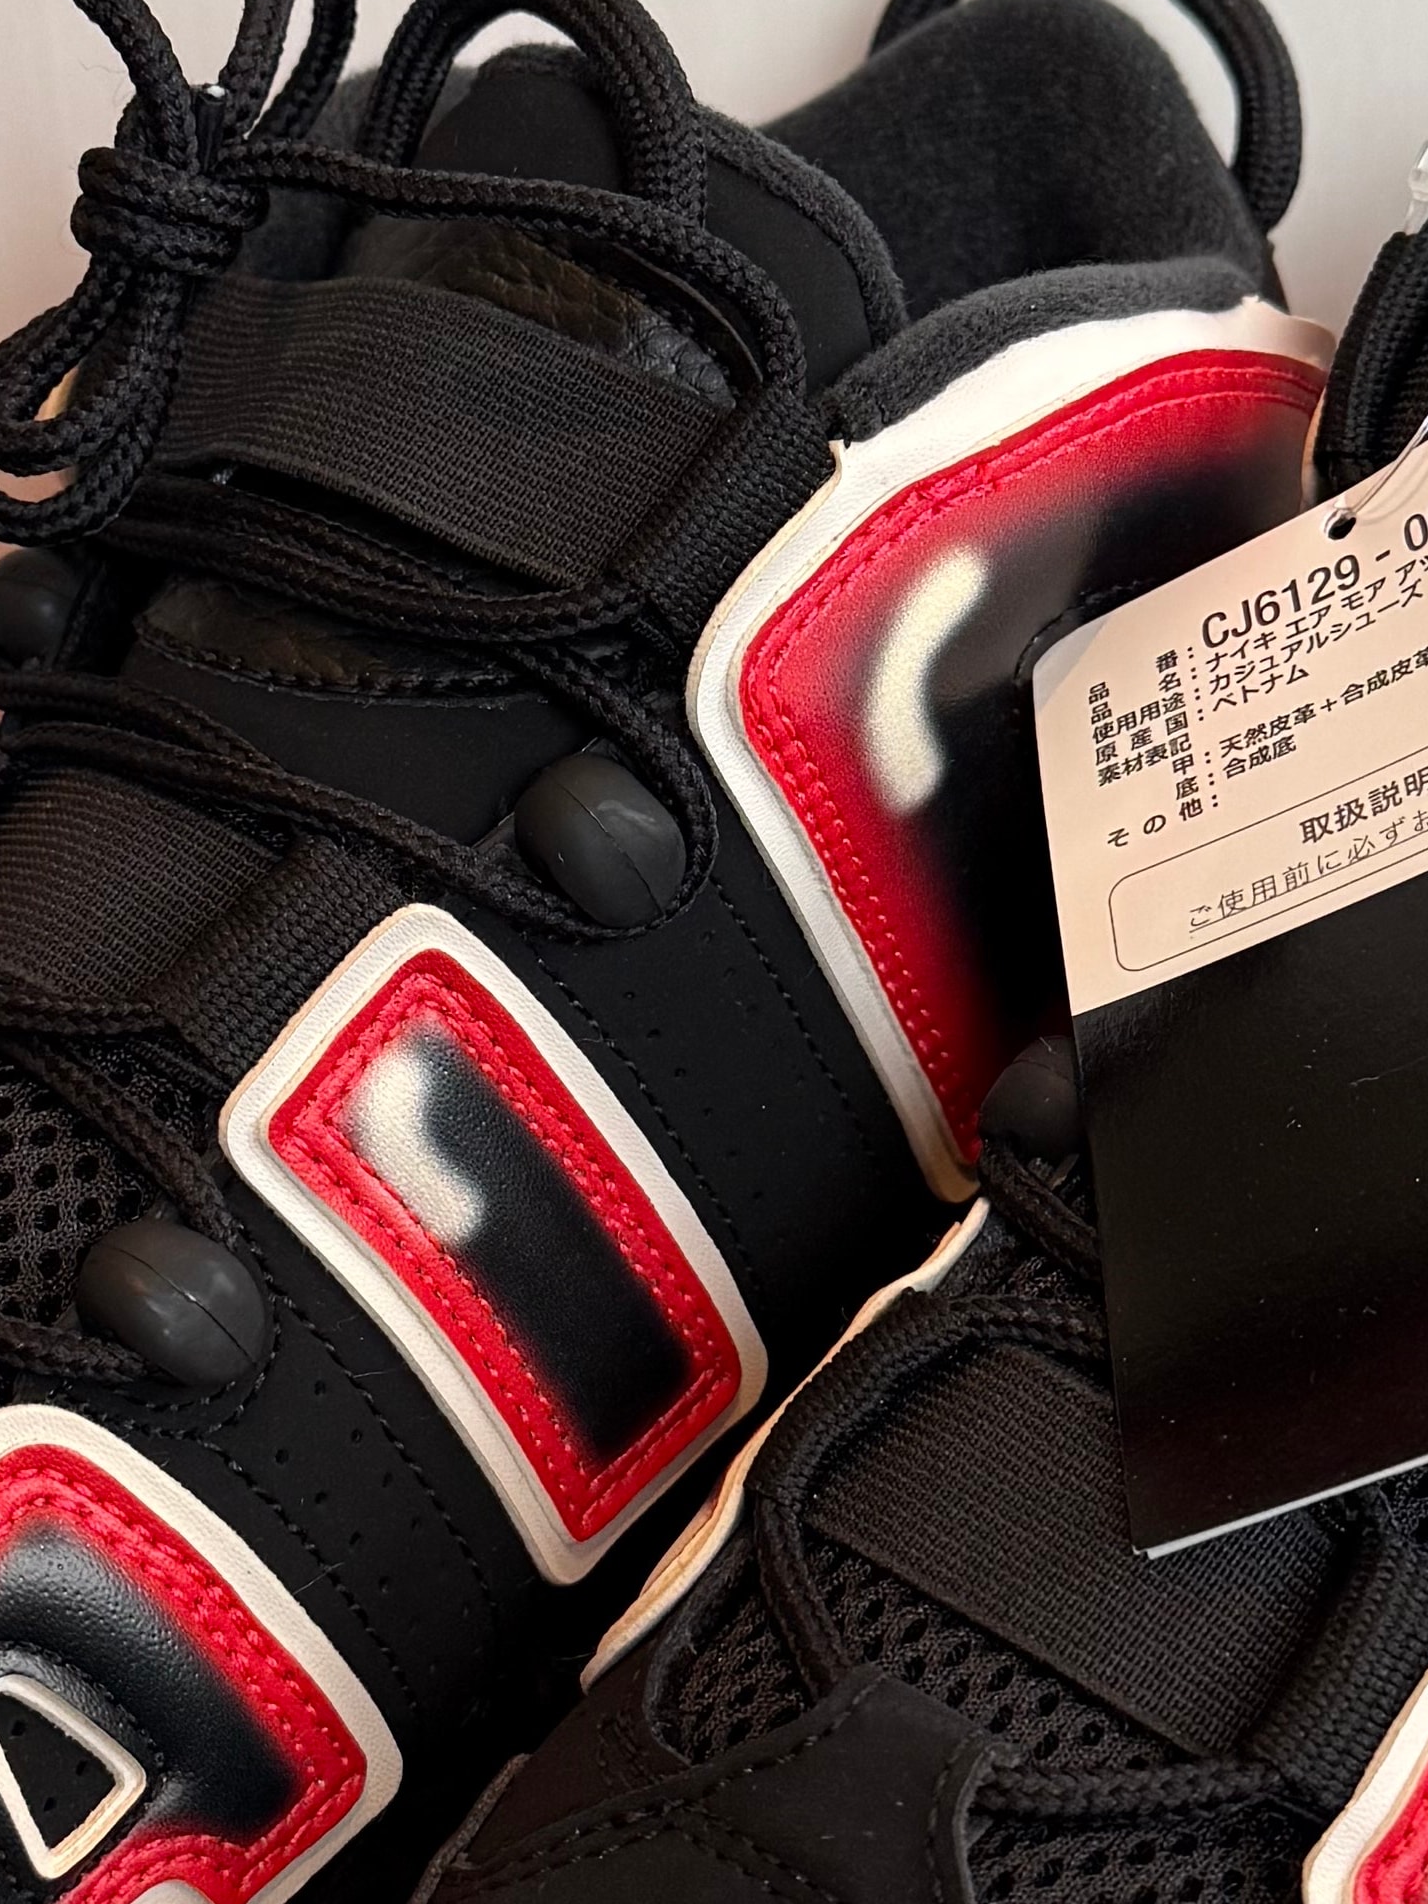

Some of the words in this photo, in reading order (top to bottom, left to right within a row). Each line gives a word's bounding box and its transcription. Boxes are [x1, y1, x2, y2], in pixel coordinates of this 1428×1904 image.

[1201, 554, 1360, 648] CJ6129
[1209, 578, 1424, 695] カジュアルシューズ
[1212, 664, 1310, 712] ベトナム
[1097, 733, 1192, 787] 素材表記
[1223, 734, 1297, 780] 合成底
